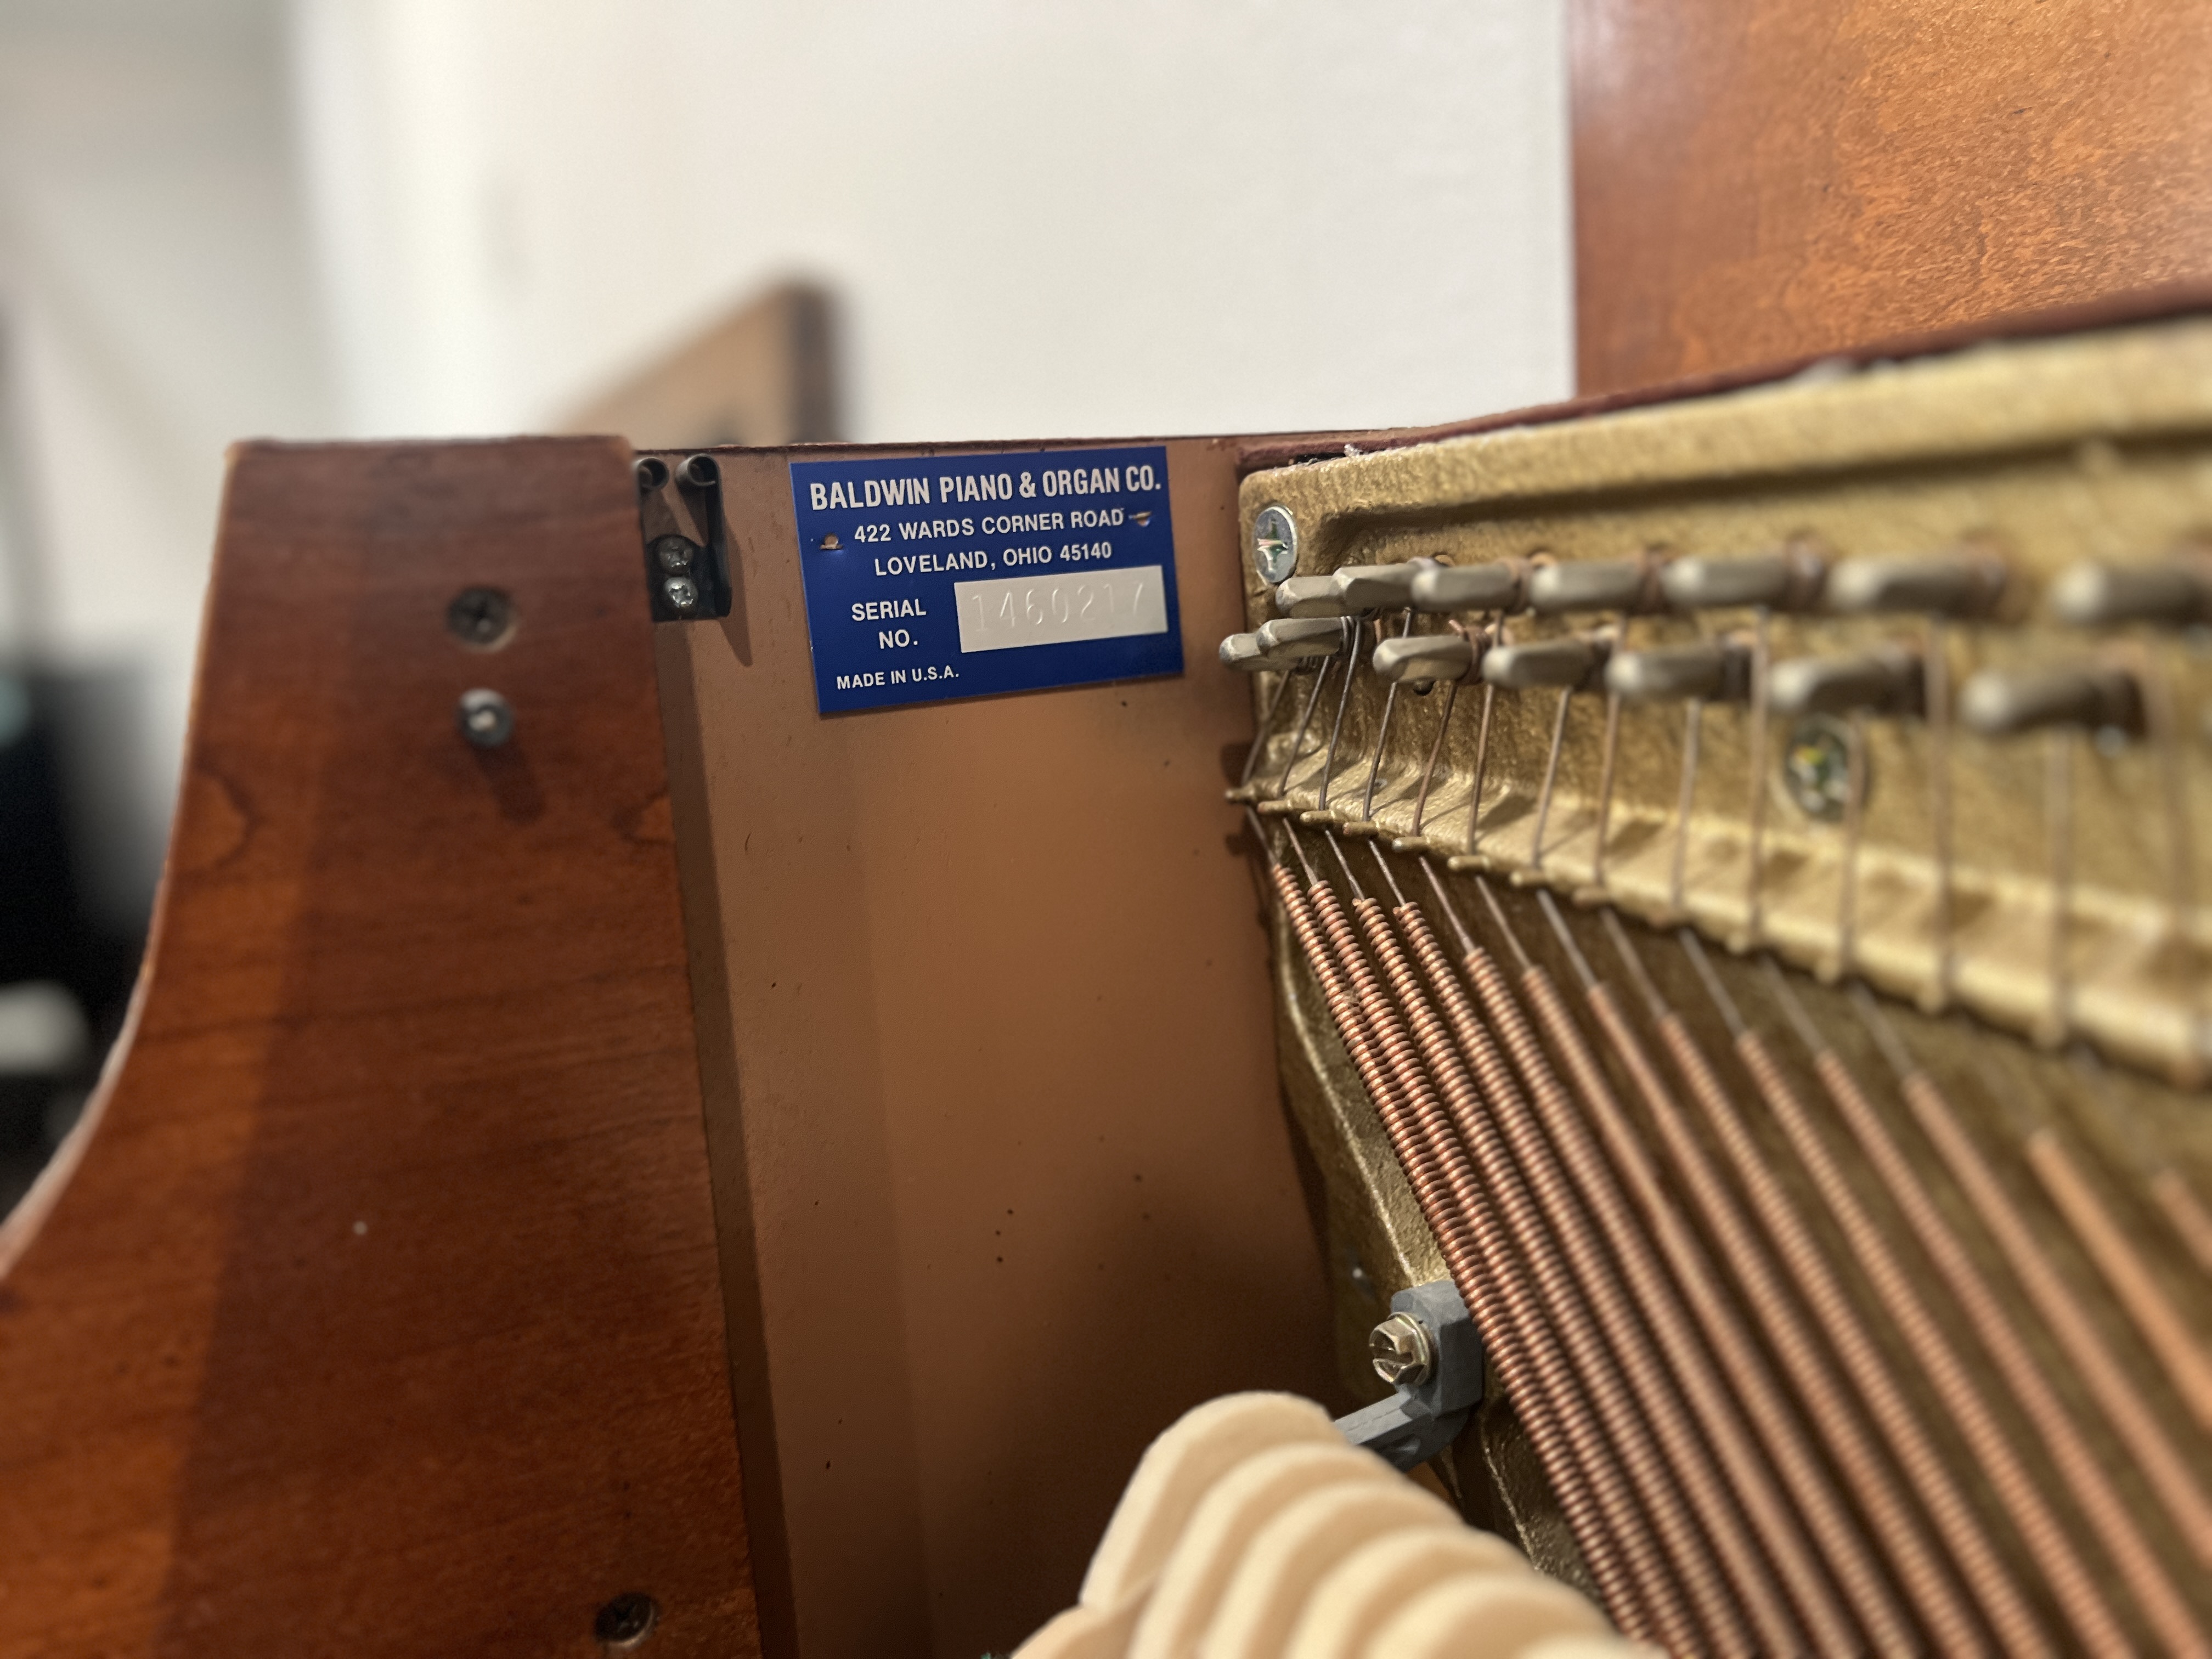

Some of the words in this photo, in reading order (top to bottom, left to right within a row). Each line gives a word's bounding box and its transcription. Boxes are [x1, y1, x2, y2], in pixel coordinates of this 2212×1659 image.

[810, 478, 930, 510] BALDWIN
[940, 473, 1012, 503] PIANO
[1019, 472, 1036, 498] &
[1042, 467, 1119, 496] ORGAN
[1126, 465, 1160, 491] CO.
[855, 524, 891, 543] 422
[899, 518, 974, 540] WARDS
[982, 513, 1064, 534] CORNER
[1071, 509, 1124, 528] ROAD
[875, 551, 995, 575] LOVELAND,
[1003, 546, 1052, 566] OHIO
[1060, 542, 1111, 561] 45140
[852, 599, 926, 621] SERIAL
[879, 629, 917, 648] NO.
[837, 672, 885, 690] MADE
[891, 670, 906, 684] IN
[912, 665, 958, 681] U.S.A.
